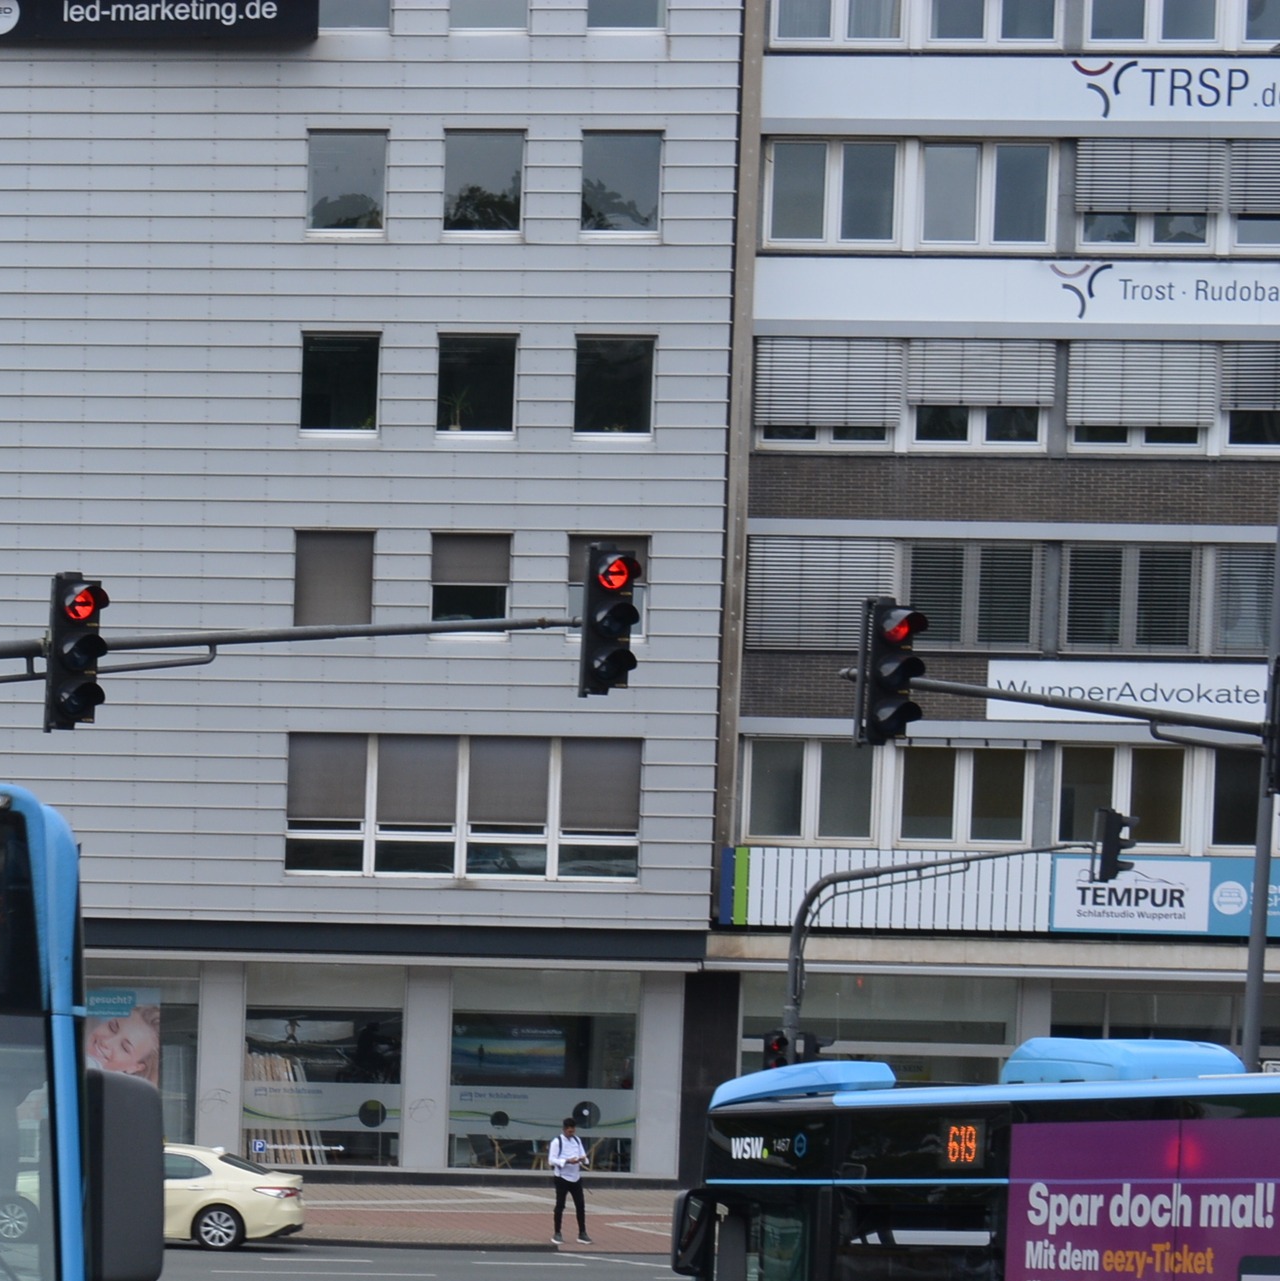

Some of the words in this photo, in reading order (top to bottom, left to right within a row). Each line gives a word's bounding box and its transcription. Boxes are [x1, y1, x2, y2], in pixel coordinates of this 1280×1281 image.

[63, 0, 278, 25] led-marketing.de
[1141, 67, 1280, 107] TRSP.d
[1119, 278, 1175, 301] Trost
[1076, 886, 1185, 908] TEMPUR
[1076, 909, 1135, 920] Schlafstudio
[1137, 911, 1187, 921] Wuppertal
[948, 1126, 977, 1162] 619
[1027, 1181, 1104, 1235] Spar
[1109, 1183, 1193, 1229] doch
[1199, 1182, 1276, 1229] mal!
[1025, 1239, 1056, 1270] Mit
[1058, 1241, 1100, 1272] dem
[1102, 1241, 1215, 1279] eezy-Ticket
